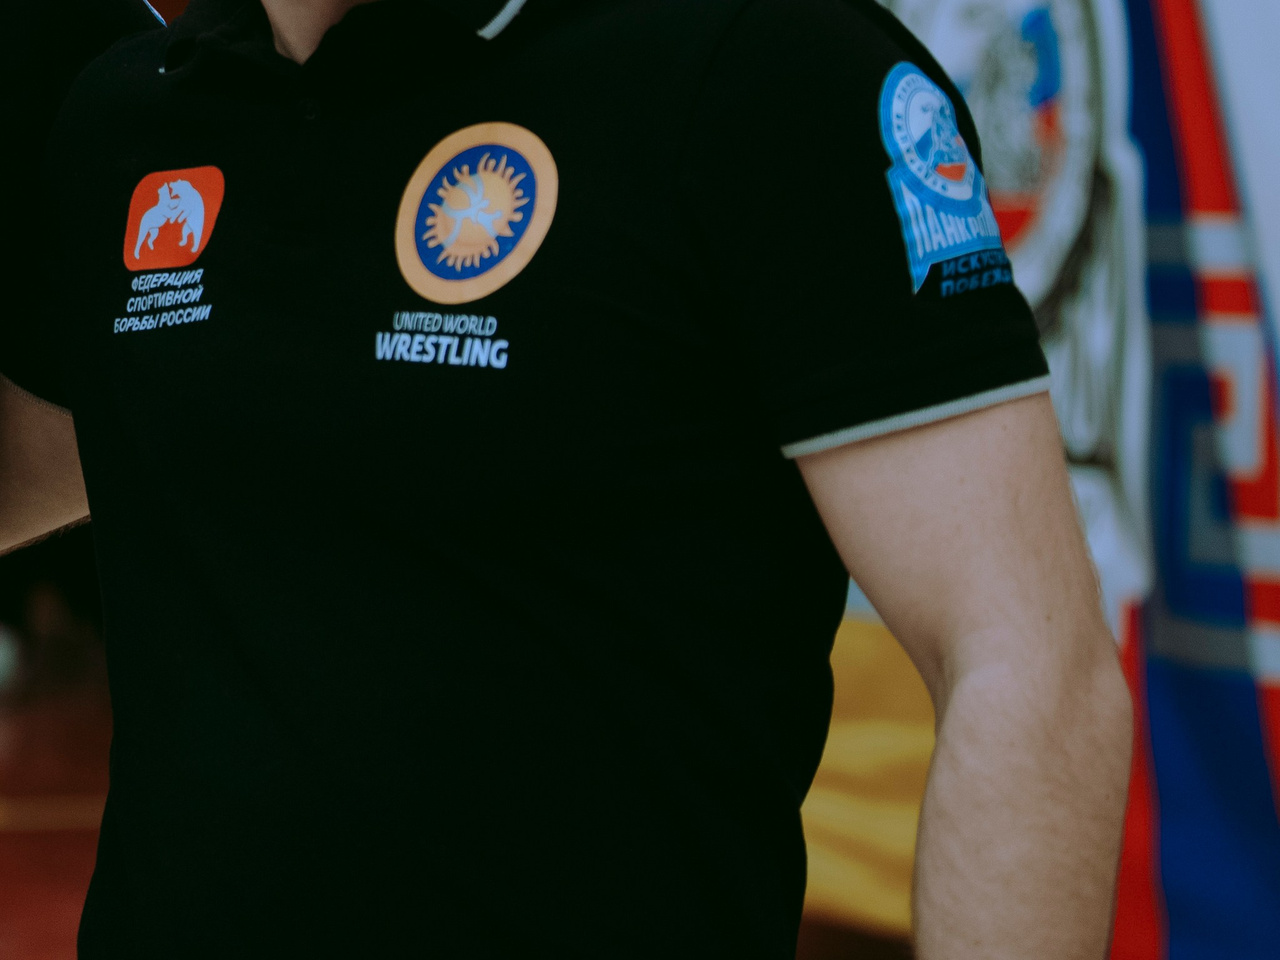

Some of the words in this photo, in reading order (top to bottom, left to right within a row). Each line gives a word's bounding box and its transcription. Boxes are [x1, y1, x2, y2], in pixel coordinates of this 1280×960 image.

[131, 268, 204, 292] ФЕДЕРАЦИЯ
[126, 284, 204, 313] СПОРТИВНОЙ
[114, 313, 159, 333] БОРЬБЫ
[159, 304, 212, 328] РОССИИ
[393, 311, 442, 332] UNITED
[443, 314, 498, 337] WORLD
[375, 331, 509, 369] WRESTLING
